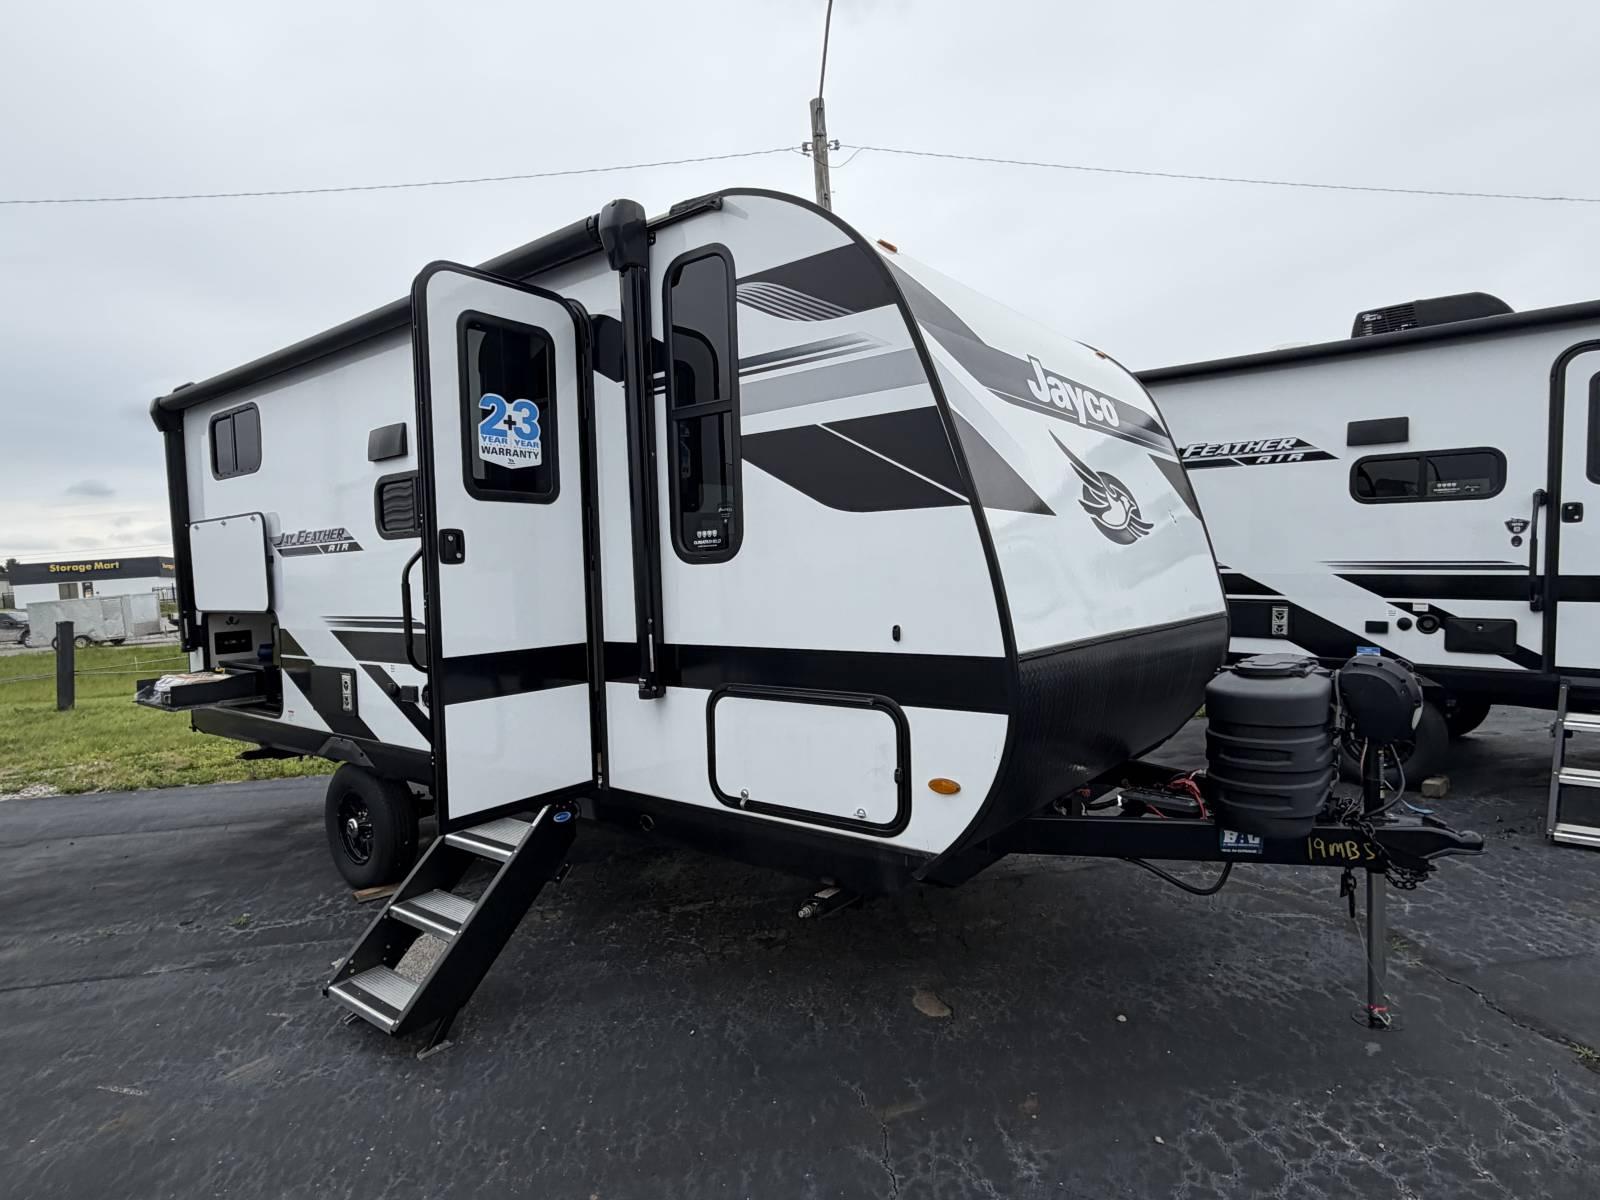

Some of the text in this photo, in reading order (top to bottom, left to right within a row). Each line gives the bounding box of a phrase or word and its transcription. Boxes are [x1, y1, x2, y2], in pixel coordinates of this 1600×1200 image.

[1027, 357, 1121, 427] Jayco
[481, 435, 539, 449] YEAR YEAR
[1182, 437, 1298, 458] FEATHER
[481, 445, 540, 460] WARRANTY
[1255, 453, 1305, 464] AIR
[297, 528, 345, 545] FEATHER
[327, 543, 349, 552] AIR
[49, 561, 120, 573] Storage Mart
